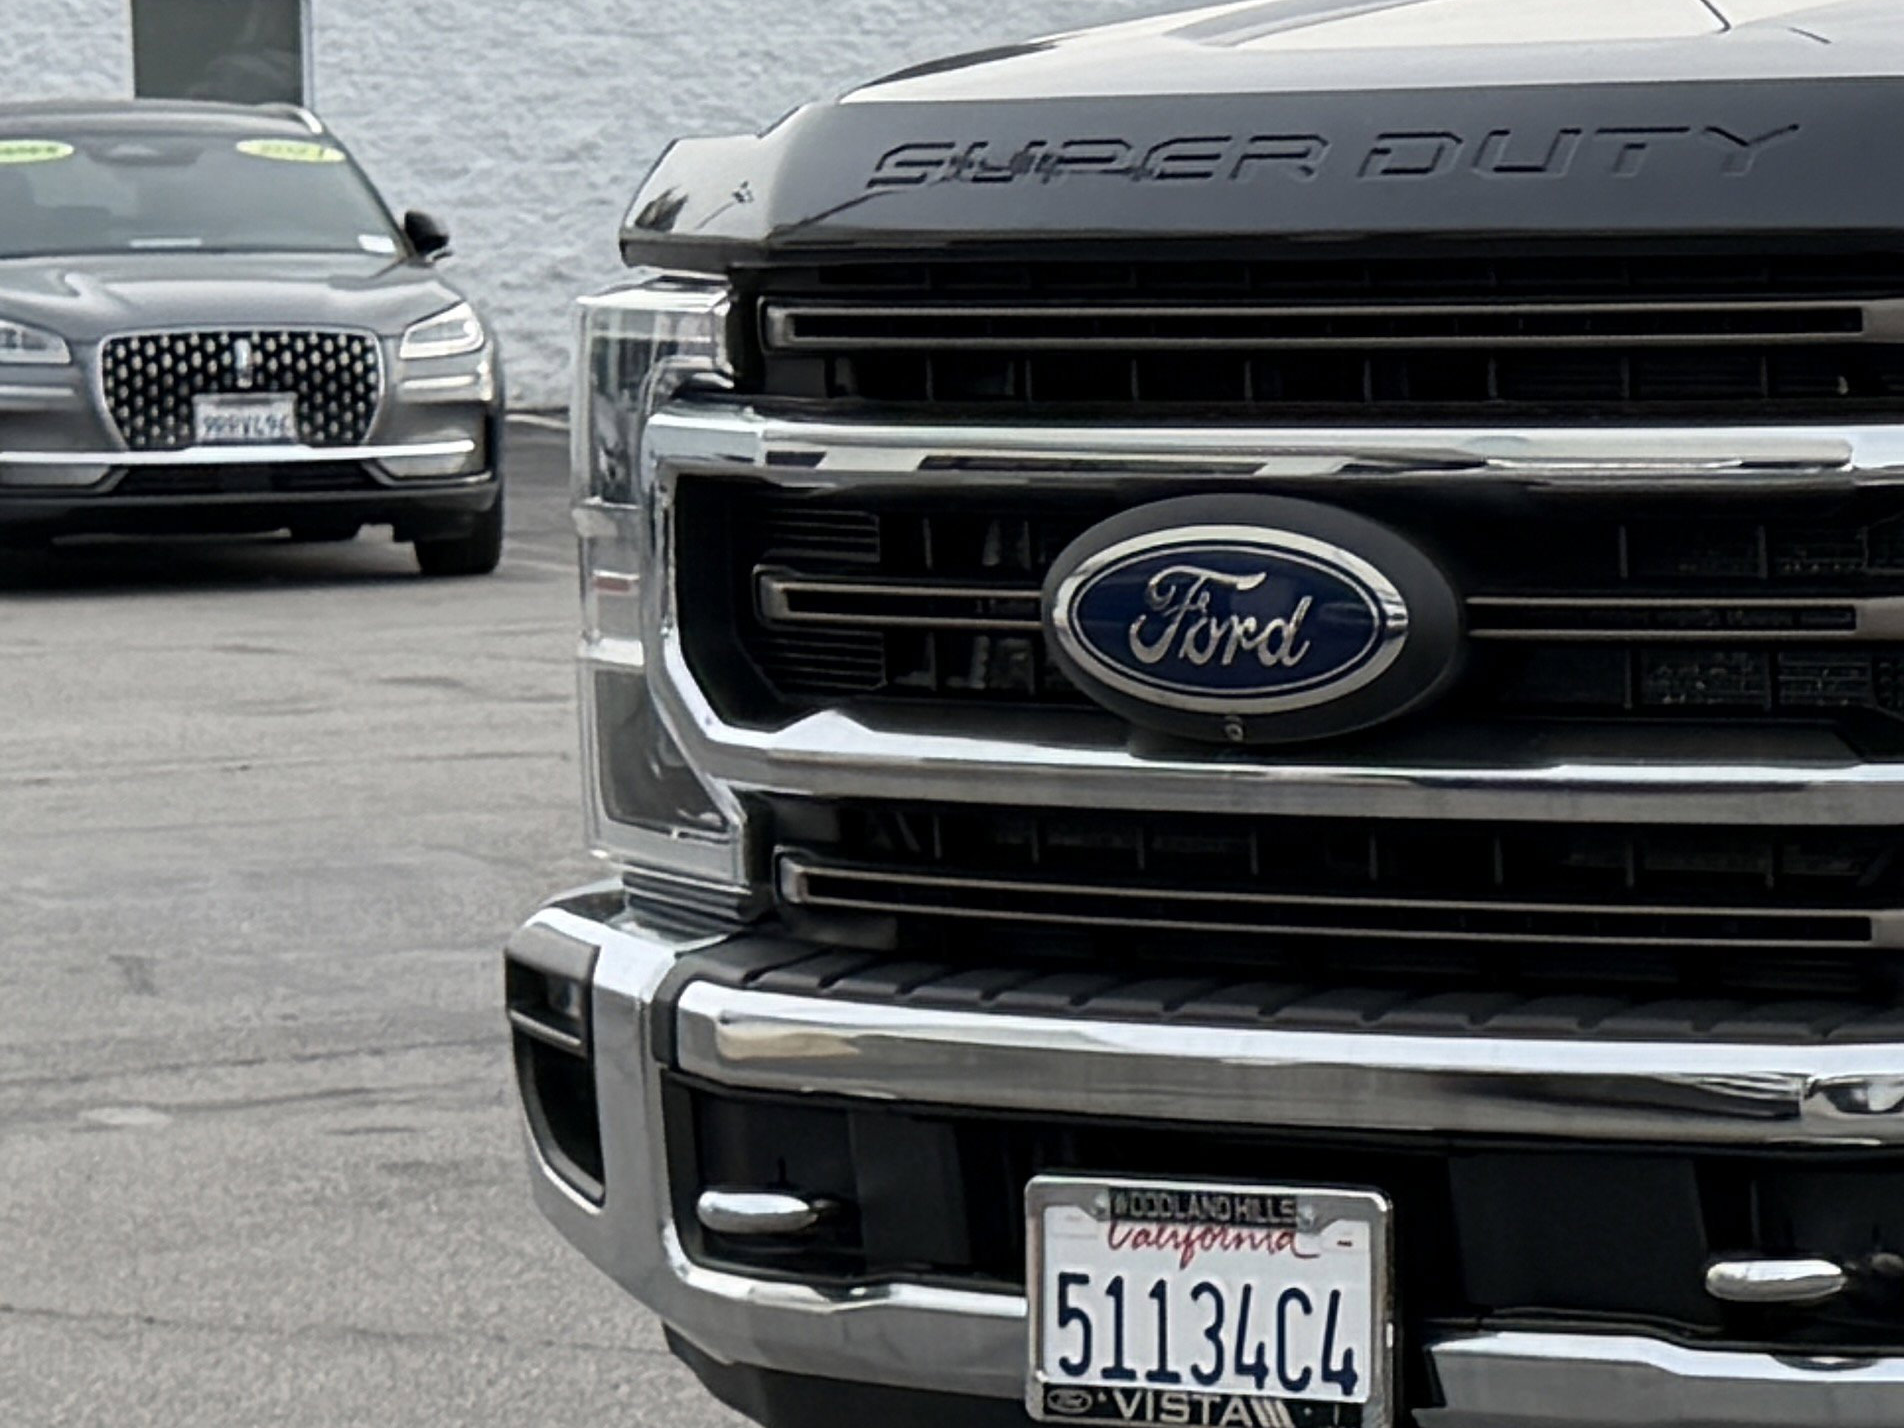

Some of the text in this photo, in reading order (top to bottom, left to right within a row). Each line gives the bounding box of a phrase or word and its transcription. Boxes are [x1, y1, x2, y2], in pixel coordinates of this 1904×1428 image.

[867, 123, 1800, 189] SUPER DUTY
[1129, 564, 1313, 668] Ford
[1113, 1188, 1297, 1225] WOODLAND HILLS
[1056, 1270, 1359, 1397] 51134C4
